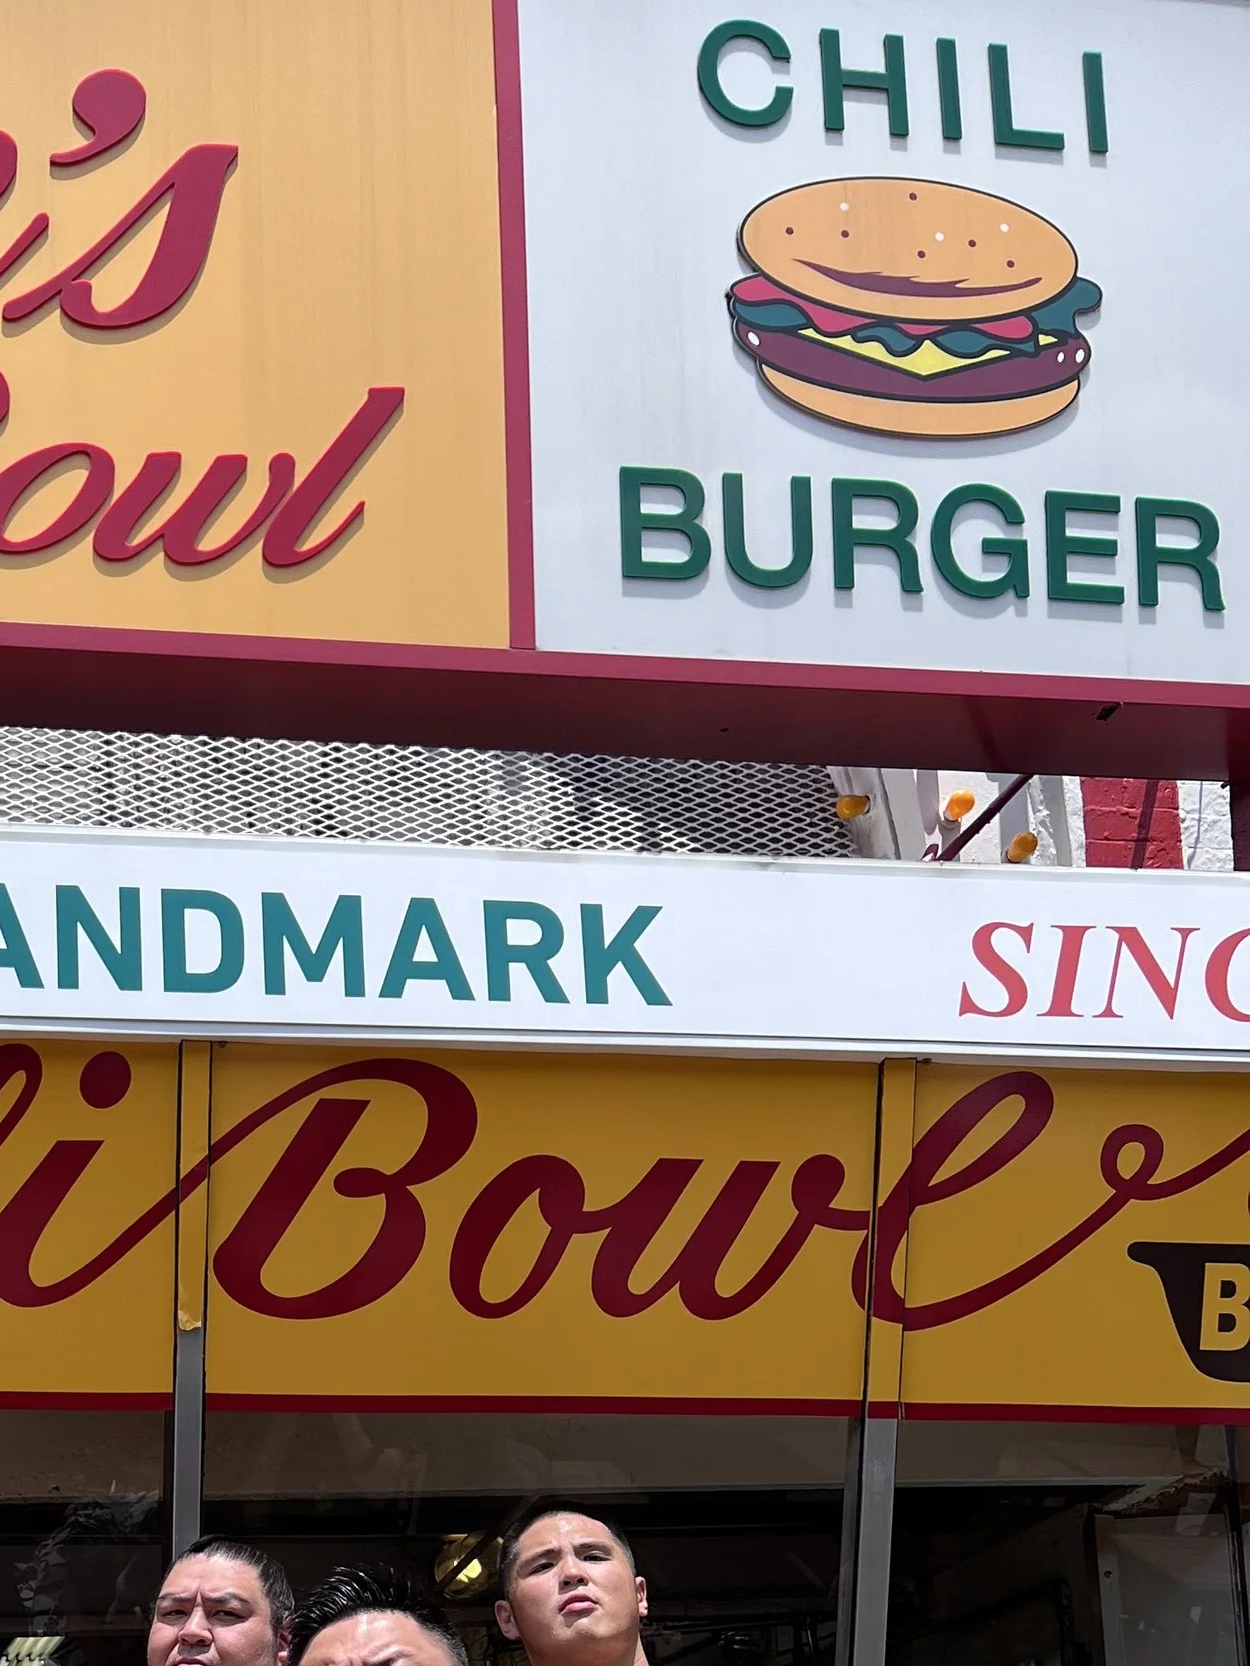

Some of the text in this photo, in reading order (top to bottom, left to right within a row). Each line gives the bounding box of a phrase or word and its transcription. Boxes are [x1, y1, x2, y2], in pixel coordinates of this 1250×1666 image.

[697, 19, 1109, 153] CHILI
[619, 466, 1225, 611] BURGER
[212, 1057, 1054, 1332] Bowl
